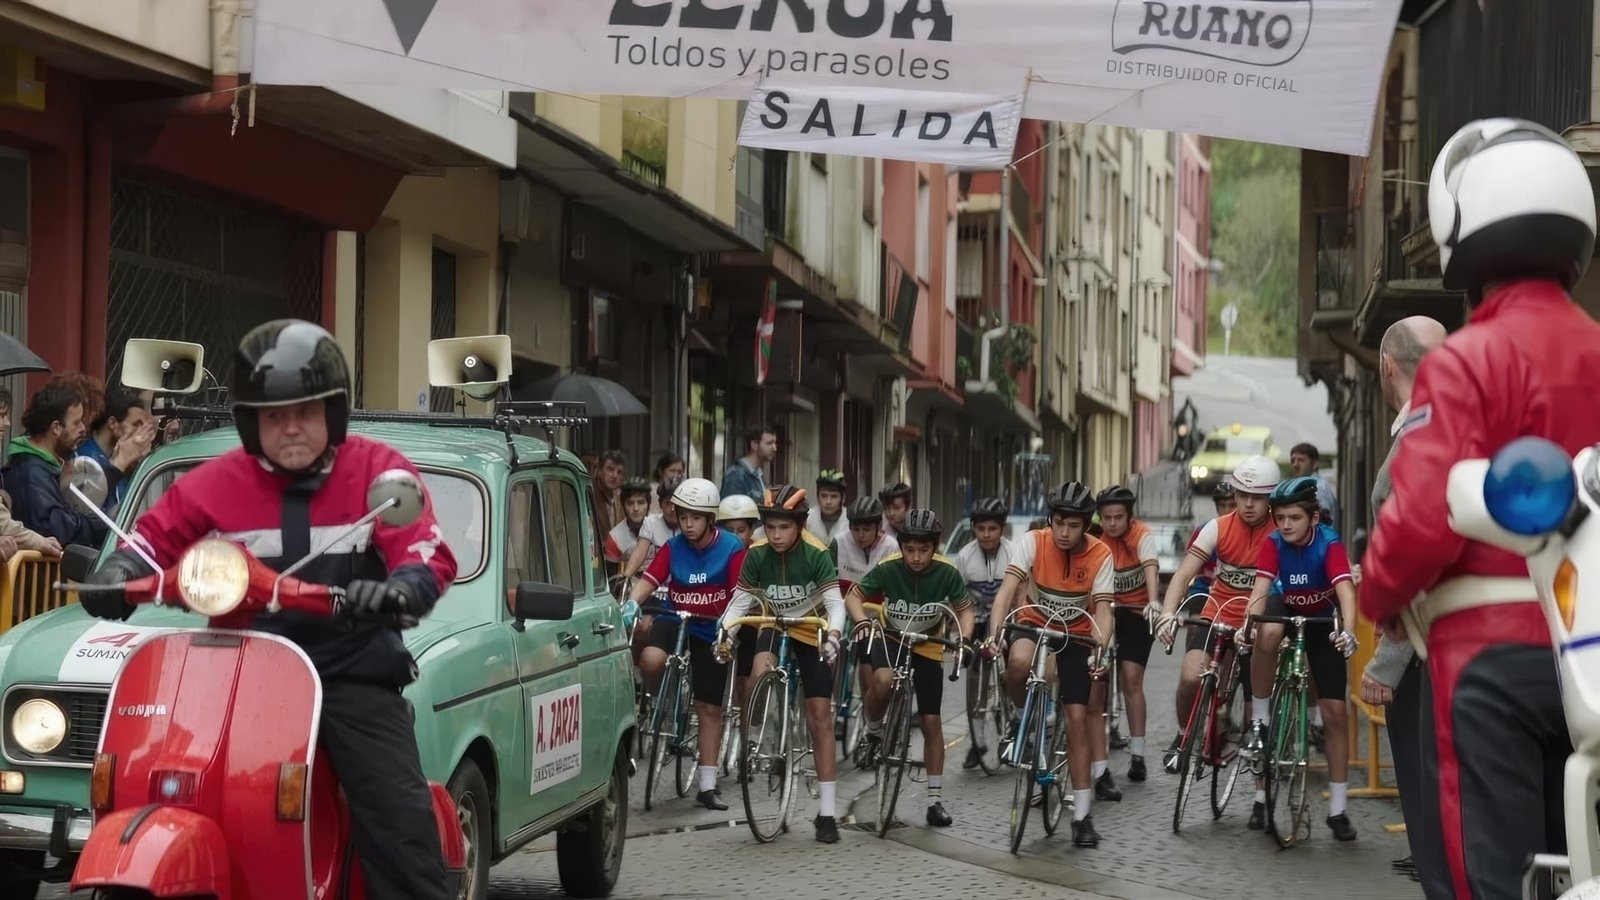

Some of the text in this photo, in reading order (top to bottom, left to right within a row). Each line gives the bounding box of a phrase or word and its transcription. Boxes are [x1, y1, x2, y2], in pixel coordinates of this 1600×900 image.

[1138, 1, 1293, 49] RUANO
[607, 35, 951, 80] Toldos y parasoles
[1106, 59, 1299, 93] DISTRIBUIDOR OFICIAL
[759, 90, 999, 149] SALIDA
[1289, 573, 1308, 585] BAR
[550, 694, 580, 751] ZARZA
